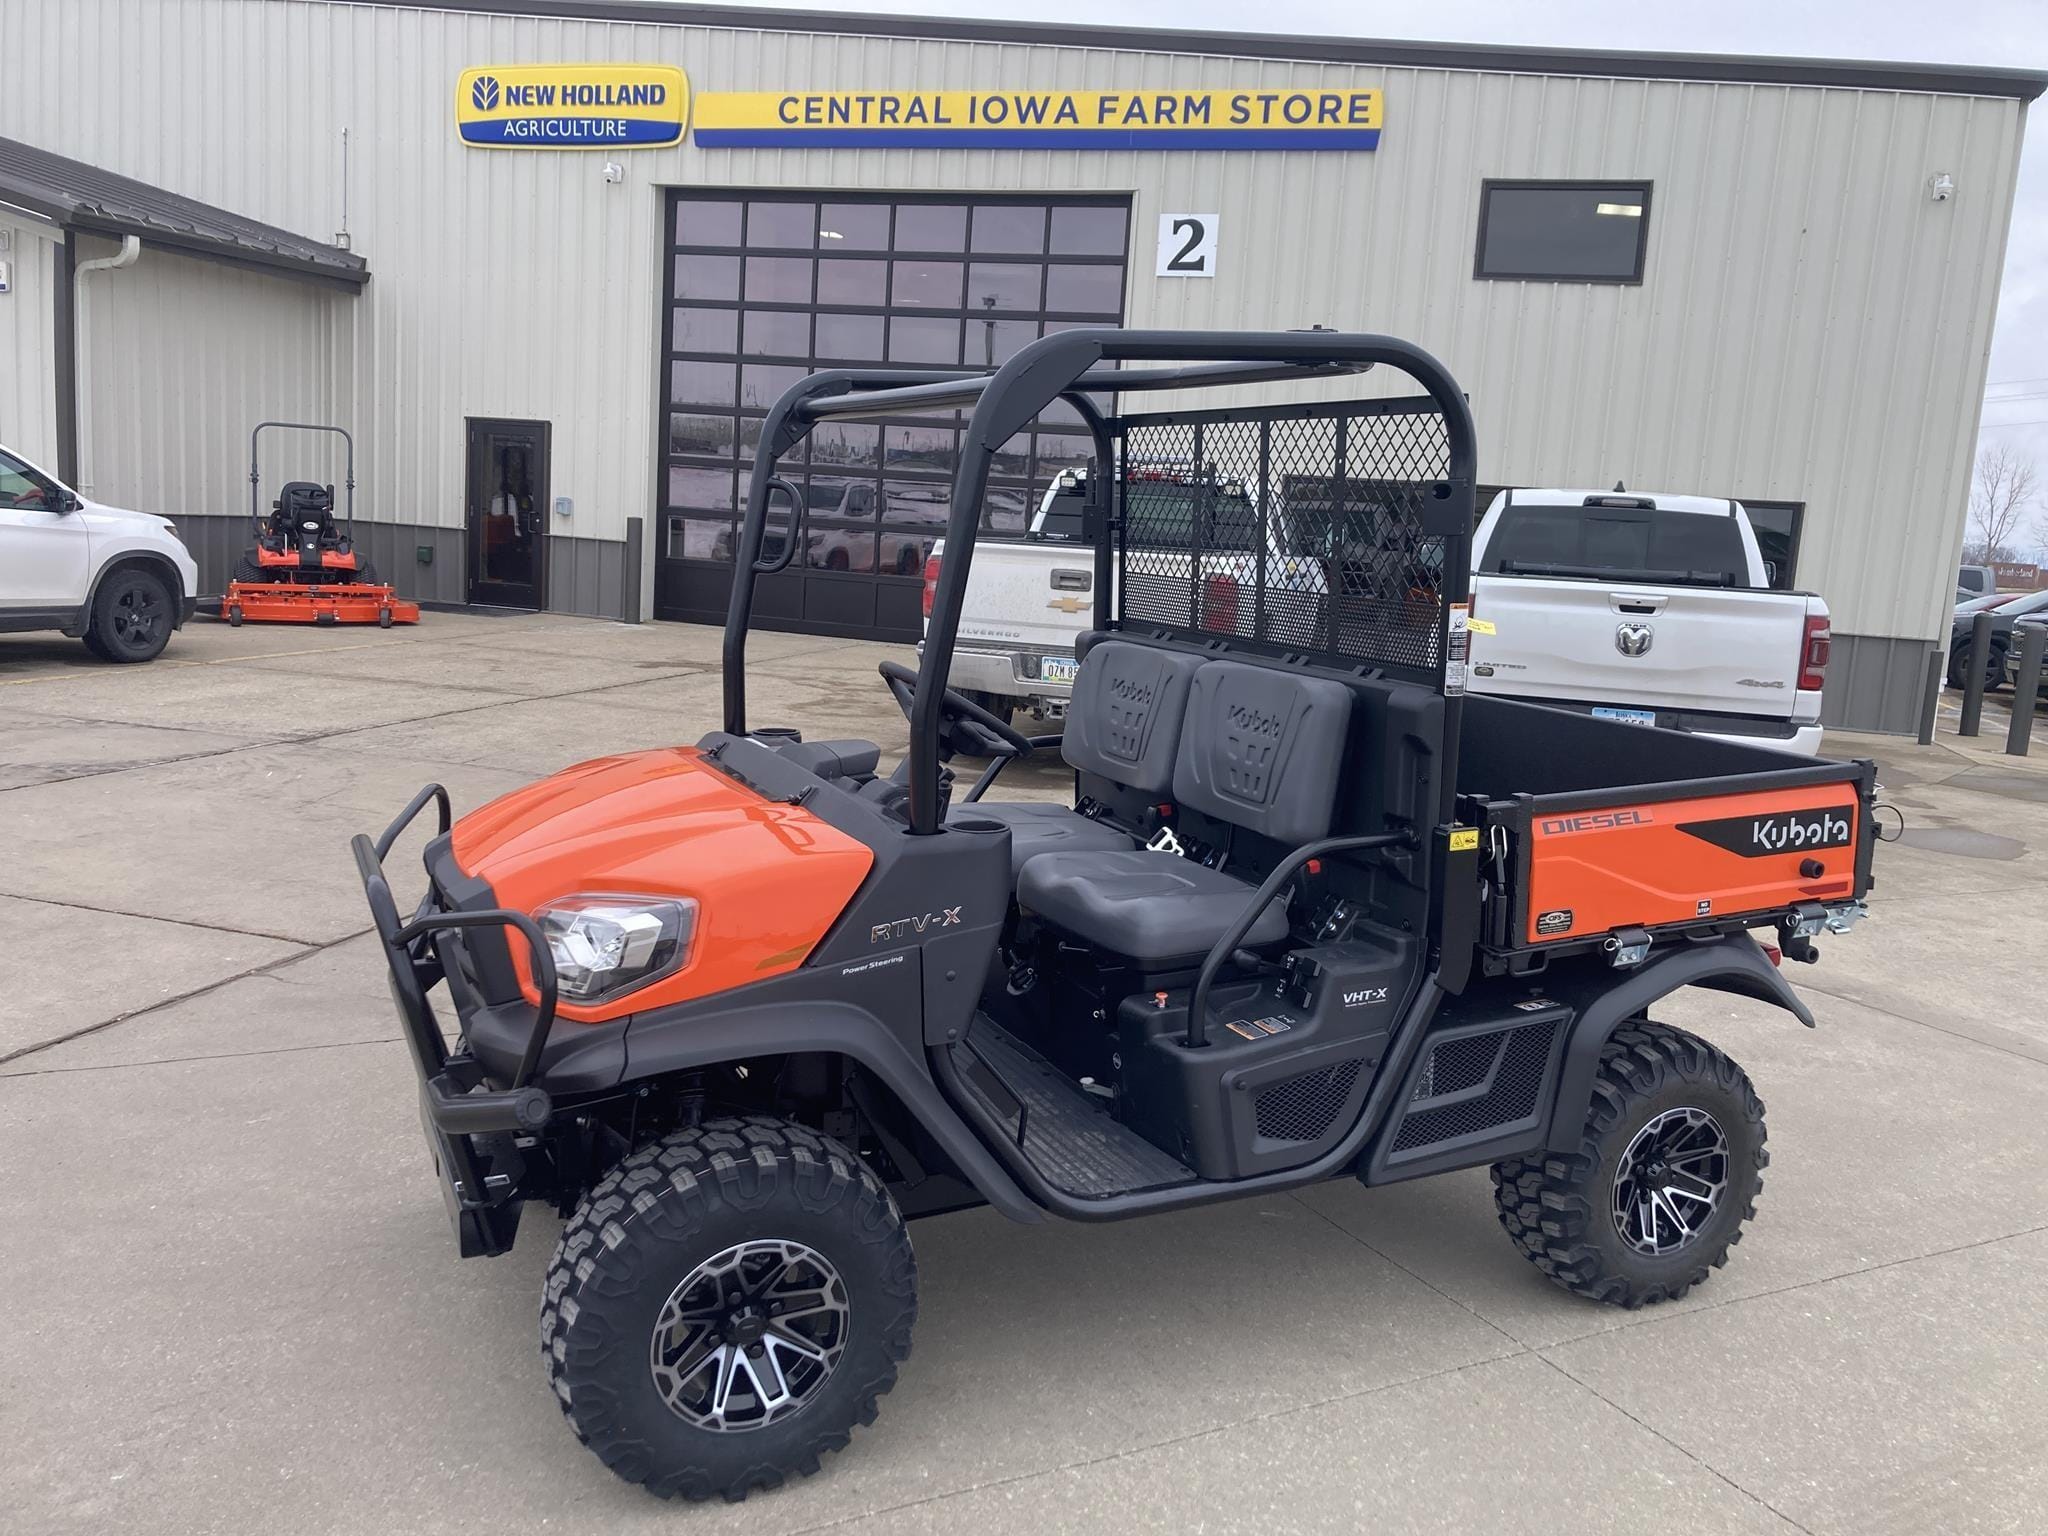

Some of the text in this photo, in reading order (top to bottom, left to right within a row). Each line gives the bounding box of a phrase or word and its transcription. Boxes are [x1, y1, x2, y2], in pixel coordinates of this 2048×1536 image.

[505, 84, 666, 106] NEW HOLLAND
[778, 94, 1371, 125] CENTRAL IOWA FARM STORE
[503, 119, 627, 137] AGRICULTURE
[1166, 218, 1205, 272] 2
[1111, 678, 1151, 704] Kubota
[1228, 705, 1280, 739] Kubota
[1541, 810, 1653, 836] DIESEL
[1753, 813, 1849, 849] Kubota
[870, 906, 962, 943] RTV-X
[842, 955, 904, 975] Power Steering
[1343, 987, 1388, 1004] VHT-X
